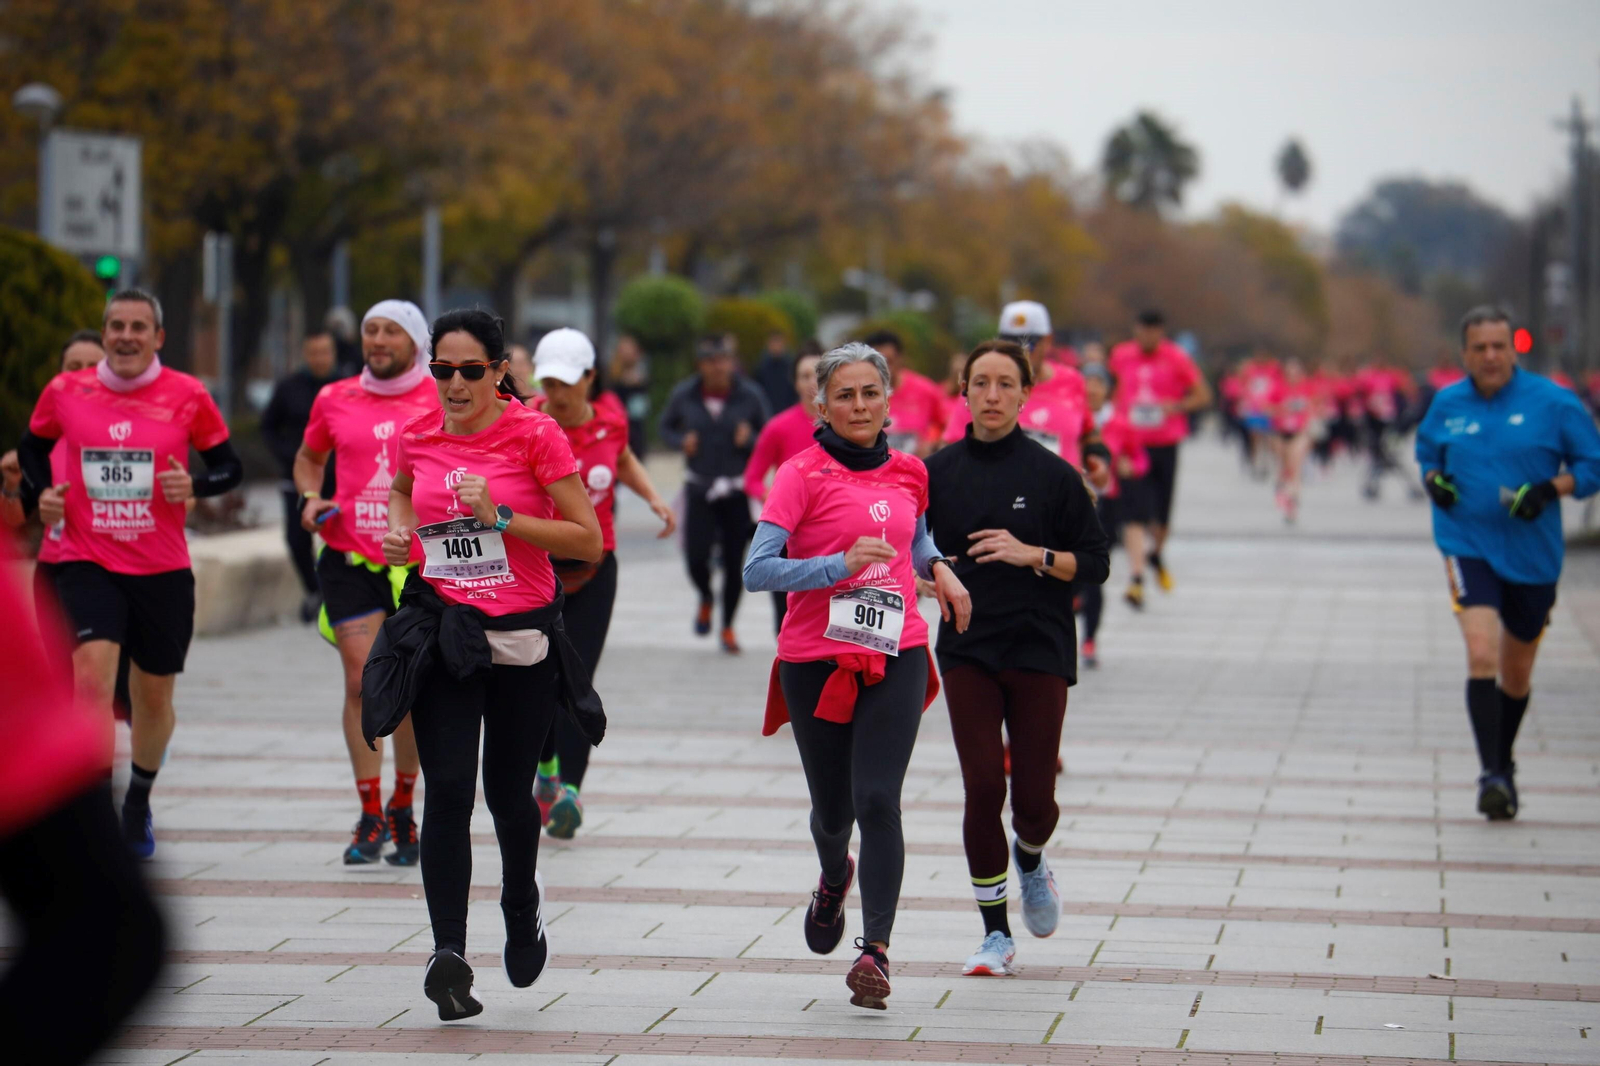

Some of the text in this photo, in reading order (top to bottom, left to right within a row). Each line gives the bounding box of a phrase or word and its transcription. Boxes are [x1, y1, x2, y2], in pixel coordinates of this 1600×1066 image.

[101, 465, 133, 483] 365
[92, 502, 152, 519] PINK
[355, 502, 389, 519] PIN
[92, 518, 156, 530] RUNNING
[355, 518, 389, 529] RUNN
[442, 537, 483, 559] 1401
[865, 577, 898, 586] EDICIÓN
[467, 590, 497, 599] 2023
[854, 604, 884, 630] 901
